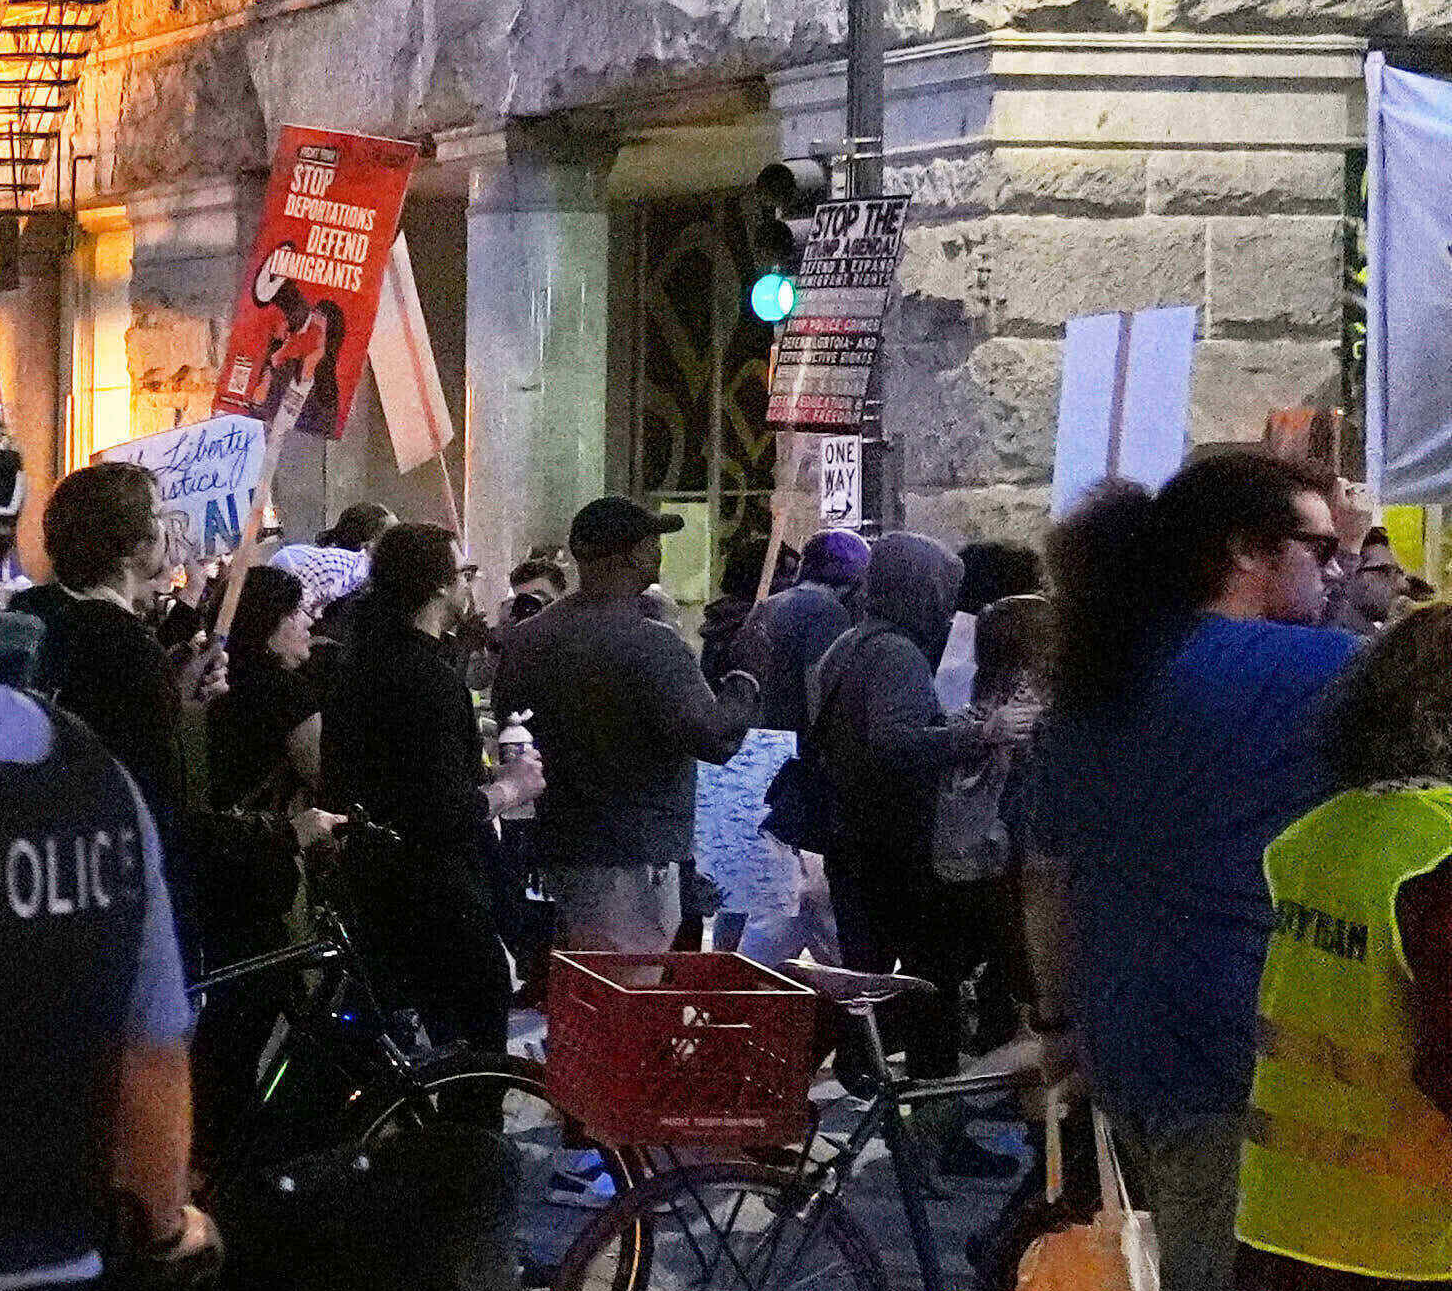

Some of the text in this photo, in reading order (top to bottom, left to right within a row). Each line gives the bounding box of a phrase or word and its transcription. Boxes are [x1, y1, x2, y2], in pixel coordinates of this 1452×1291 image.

[290, 163, 335, 197] STOP
[283, 192, 377, 232] DEPORTATIONS
[812, 200, 905, 239] STOP THE
[306, 224, 370, 264] DEFEND
[269, 248, 364, 292] IMMIGRANTS
[155, 422, 258, 492] Liberty
[826, 442, 855, 464] ONE
[825, 468, 855, 496] WAY
